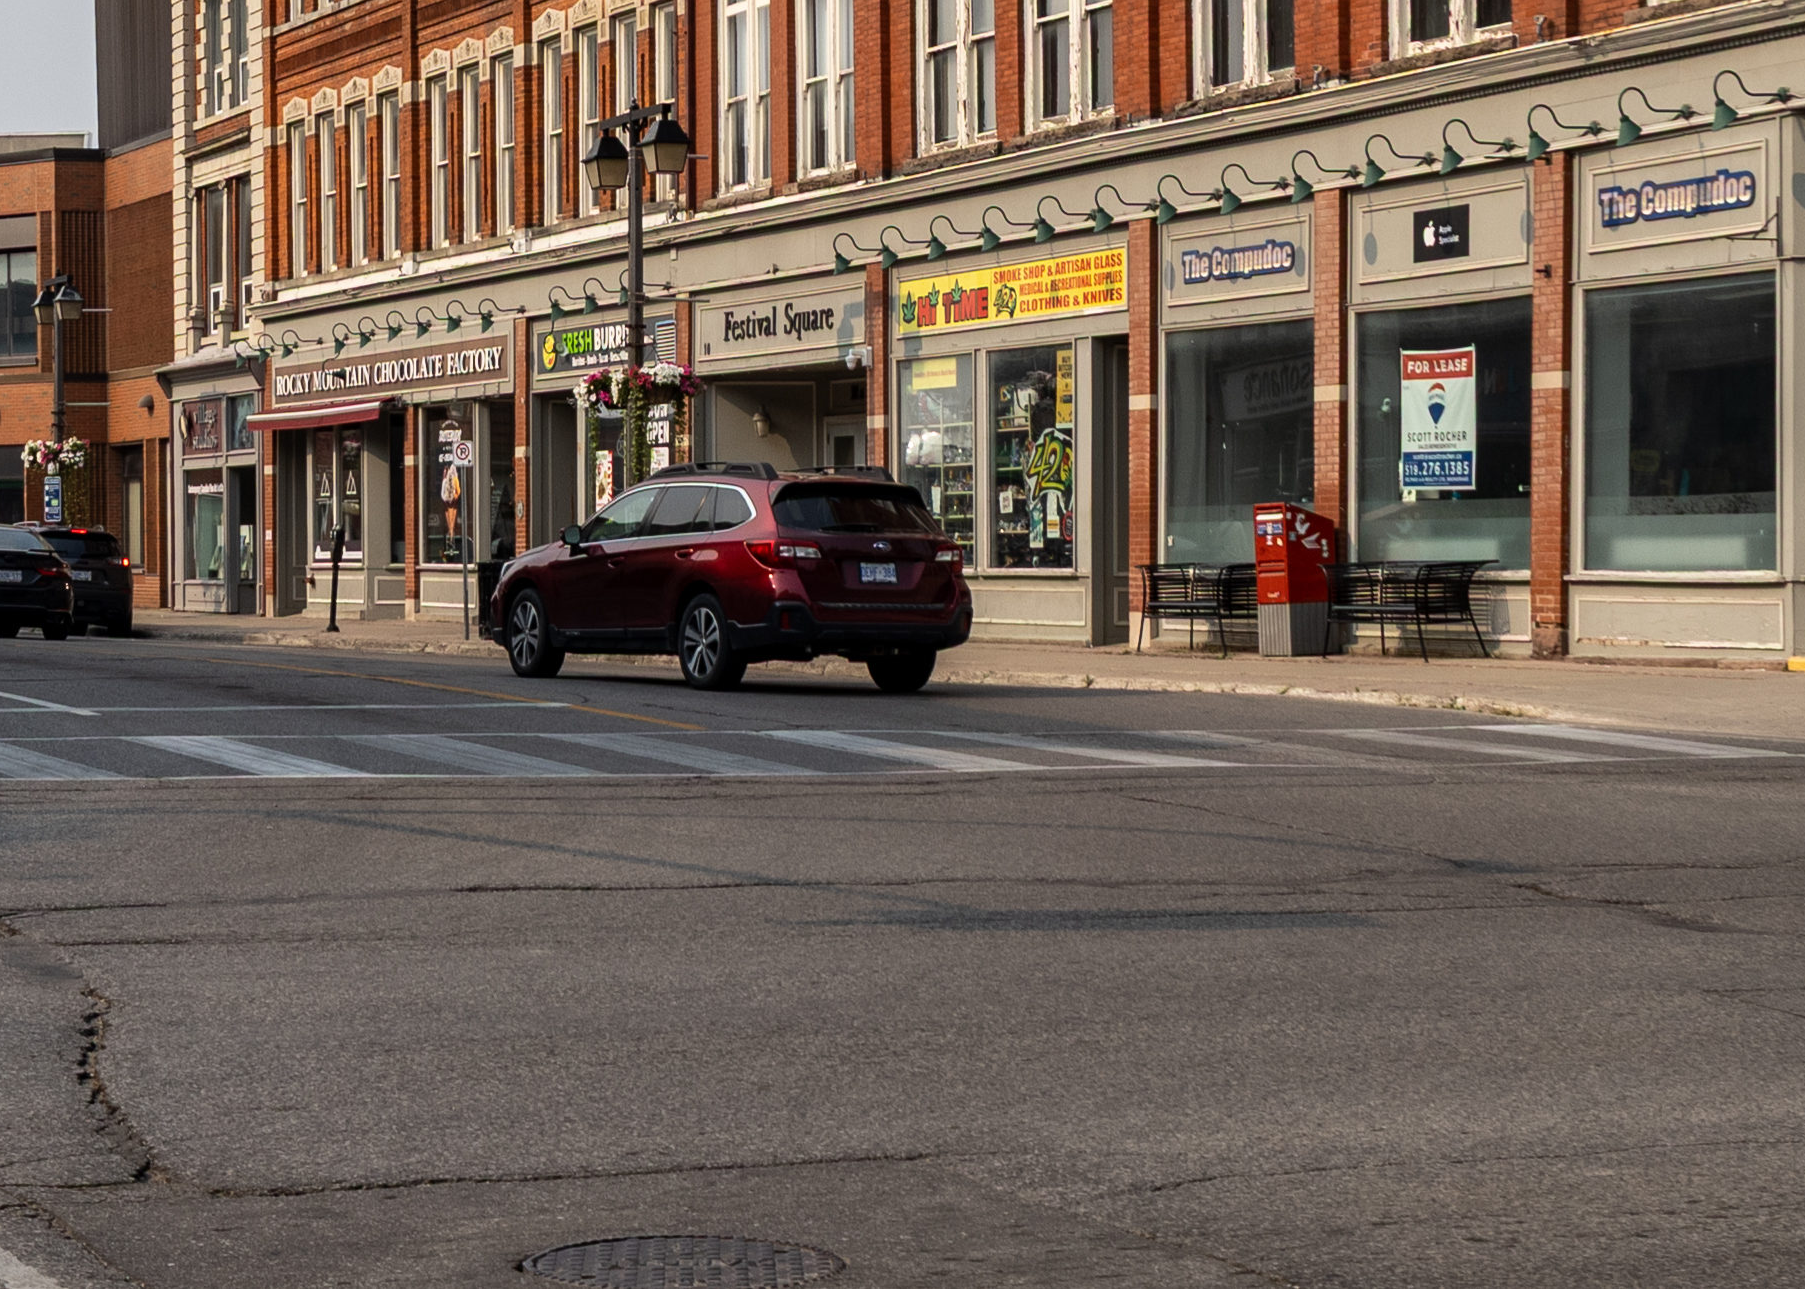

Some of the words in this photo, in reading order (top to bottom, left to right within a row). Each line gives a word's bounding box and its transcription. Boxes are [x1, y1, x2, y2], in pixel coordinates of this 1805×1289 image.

[1600, 191, 1637, 221] The
[1641, 175, 1752, 215] Compudoc
[993, 268, 1021, 284] SMOKE
[1023, 264, 1045, 280] SHOP
[1047, 265, 1053, 277] &
[1054, 257, 1091, 276] ARTISAN
[1093, 252, 1123, 271] GLASS
[1183, 254, 1209, 279] The
[1212, 243, 1292, 276] Compudoc
[1019, 281, 1044, 296] MEDICAL
[1050, 275, 1092, 292] RECREATIONAL
[1093, 270, 1123, 287] SUPPLIES
[1019, 294, 1070, 313] CLOTHING
[1072, 294, 1080, 306] &
[1083, 287, 1123, 305] KNIVES
[723, 305, 778, 342] Festival
[783, 302, 835, 342] Square
[561, 329, 594, 354] FRESH
[594, 325, 630, 351] BURRI
[703, 342, 711, 356] 10
[276, 371, 311, 396] ROCKY
[374, 354, 443, 384] CHOCOLATE
[446, 345, 503, 376] FACTORY
[1407, 360, 1431, 374] FOR
[1433, 357, 1468, 373] LEASE
[646, 420, 670, 444] OPEN
[1407, 431, 1432, 442] SCOTT
[1434, 430, 1467, 442] ROCHER
[1405, 460, 1469, 476] 519.276.1385
